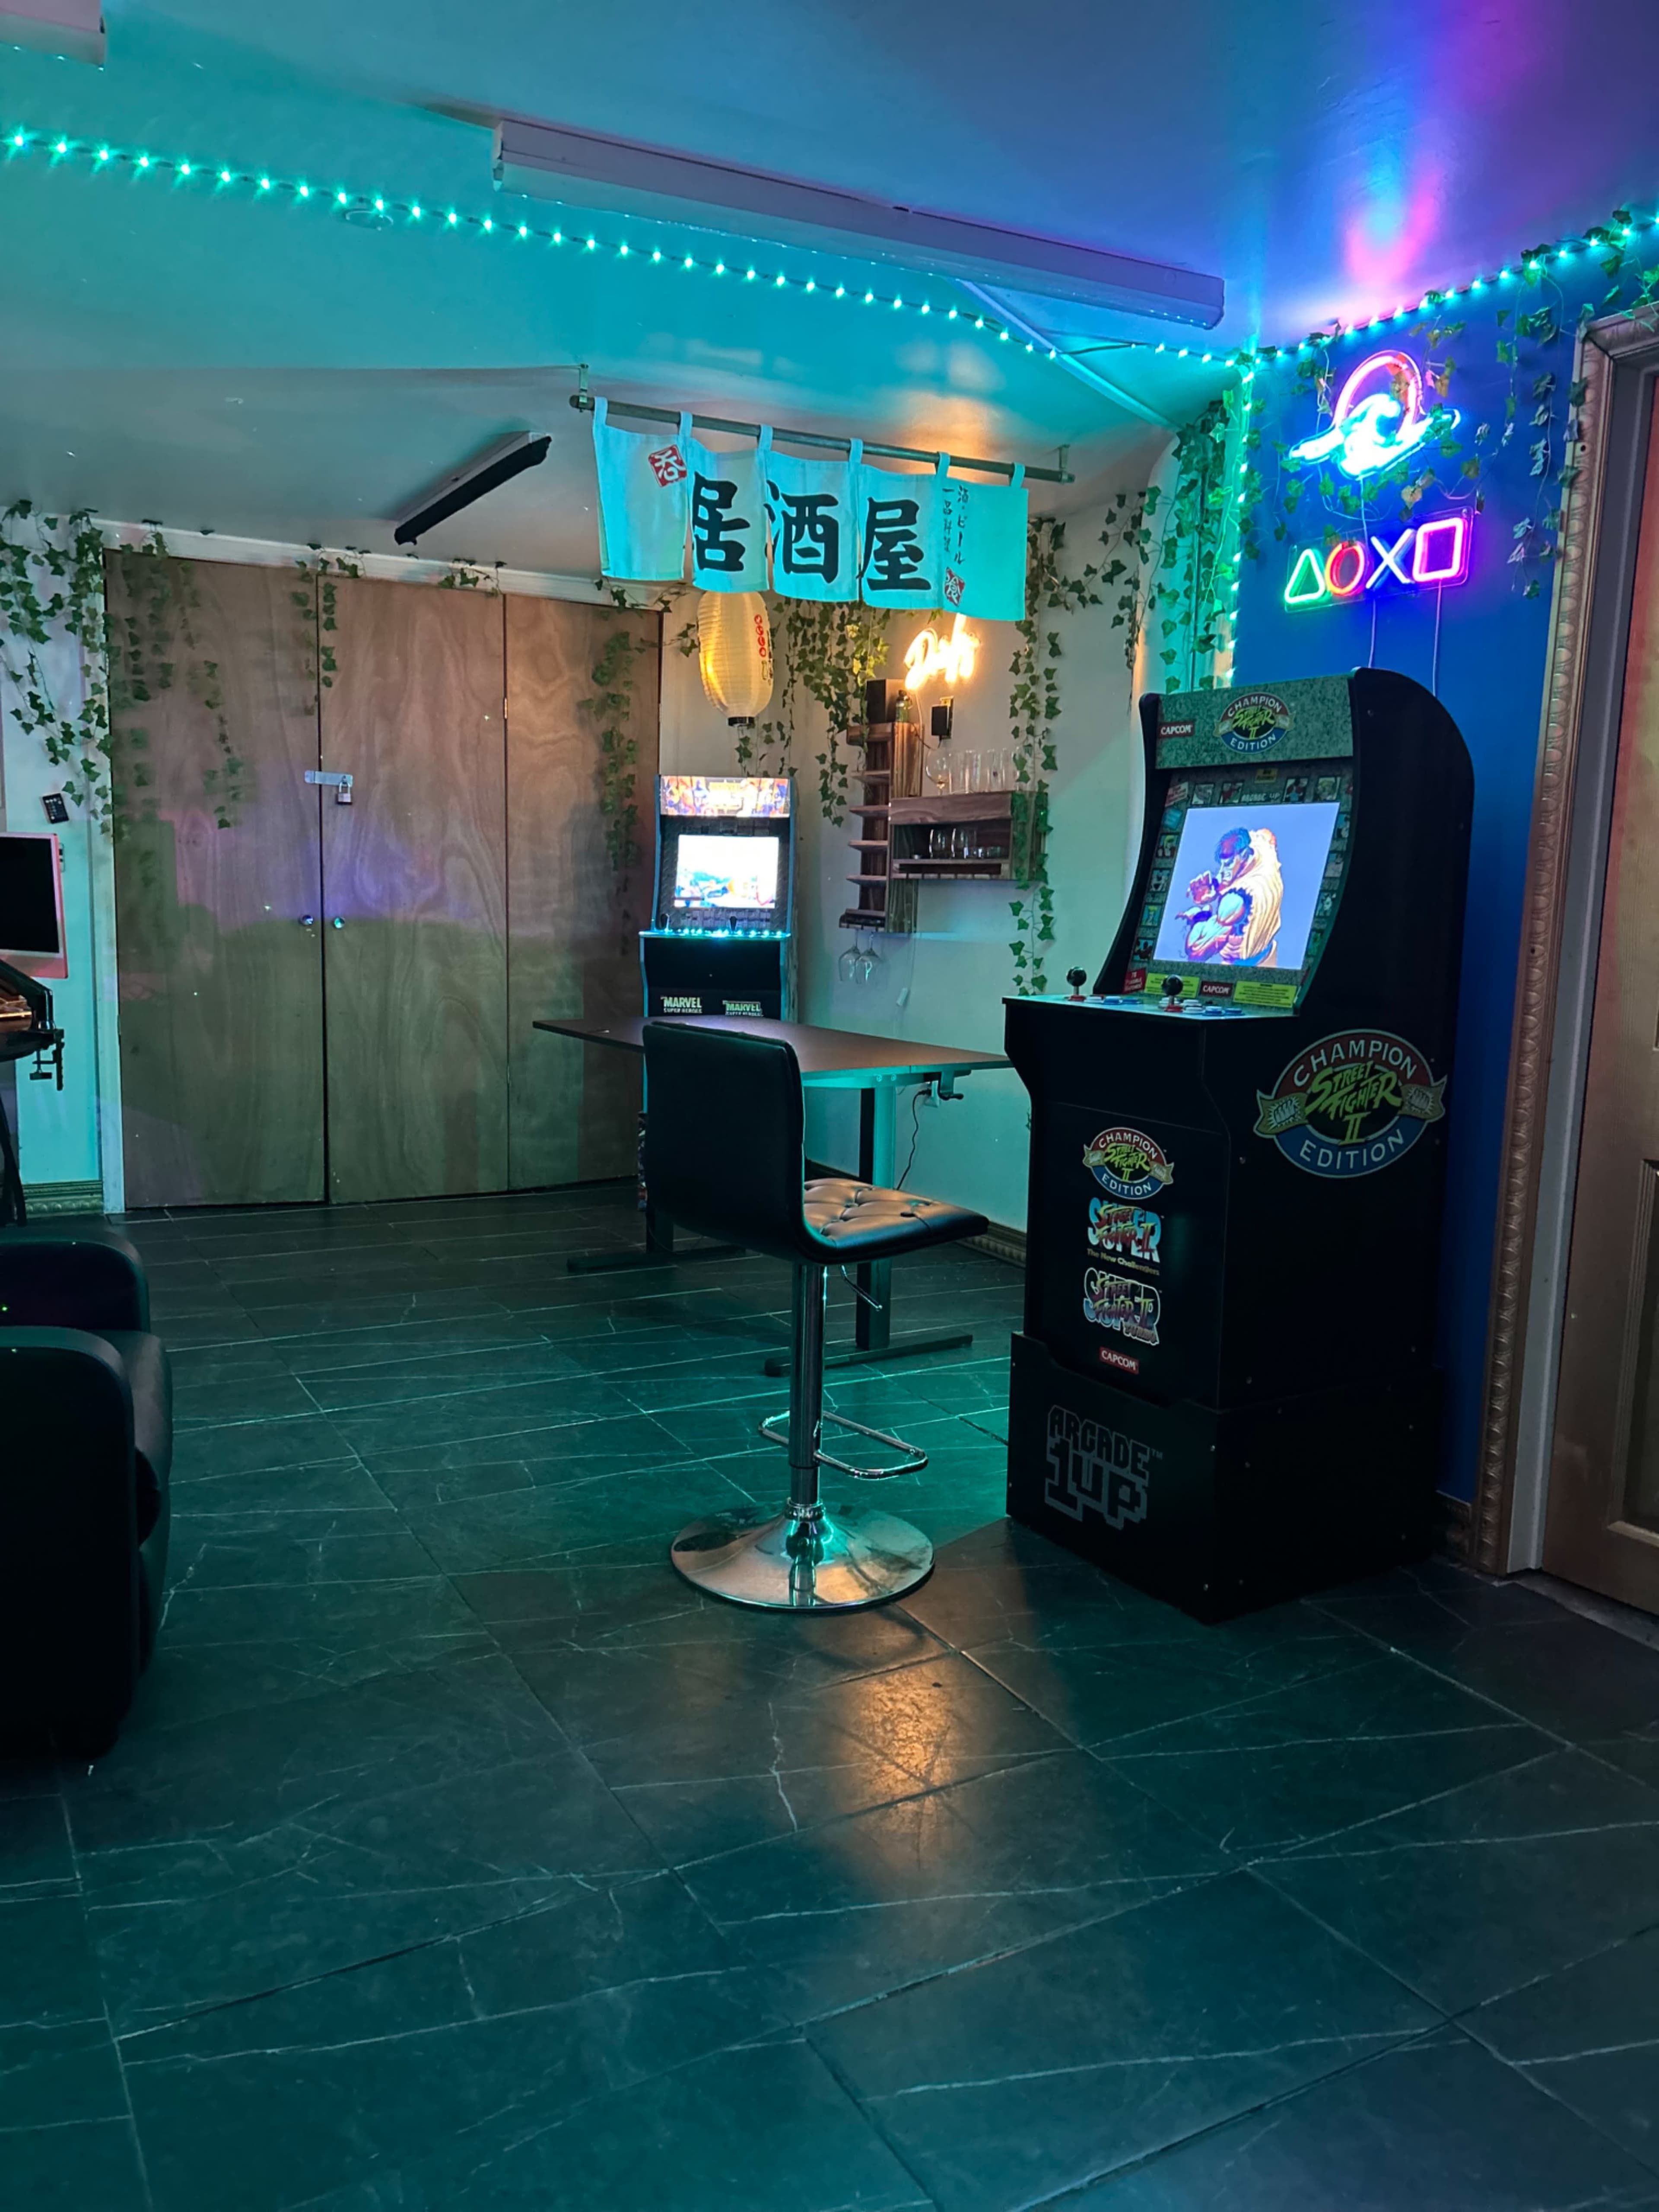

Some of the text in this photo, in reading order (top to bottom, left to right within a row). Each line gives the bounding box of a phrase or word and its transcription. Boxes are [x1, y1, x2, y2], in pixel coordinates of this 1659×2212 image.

[691, 470, 932, 591] 居酒屋
[1228, 696, 1282, 716] CHAMPION
[1160, 724, 1192, 735] CAPCOM
[1230, 734, 1276, 750] EDITION
[1202, 985, 1230, 995] CAPCOM
[663, 997, 702, 1008] MARVEL
[726, 1003, 760, 1011] MARVEL
[1293, 1039, 1417, 1087] CHAMPION
[1338, 1111, 1371, 1145] II
[1099, 1132, 1158, 1160] CHAMPION
[1299, 1128, 1405, 1170] EDITION
[1101, 1173, 1151, 1196] EDITION
[1101, 1351, 1136, 1370] CAPCOM
[1047, 1404, 1150, 1487] ARCADE
